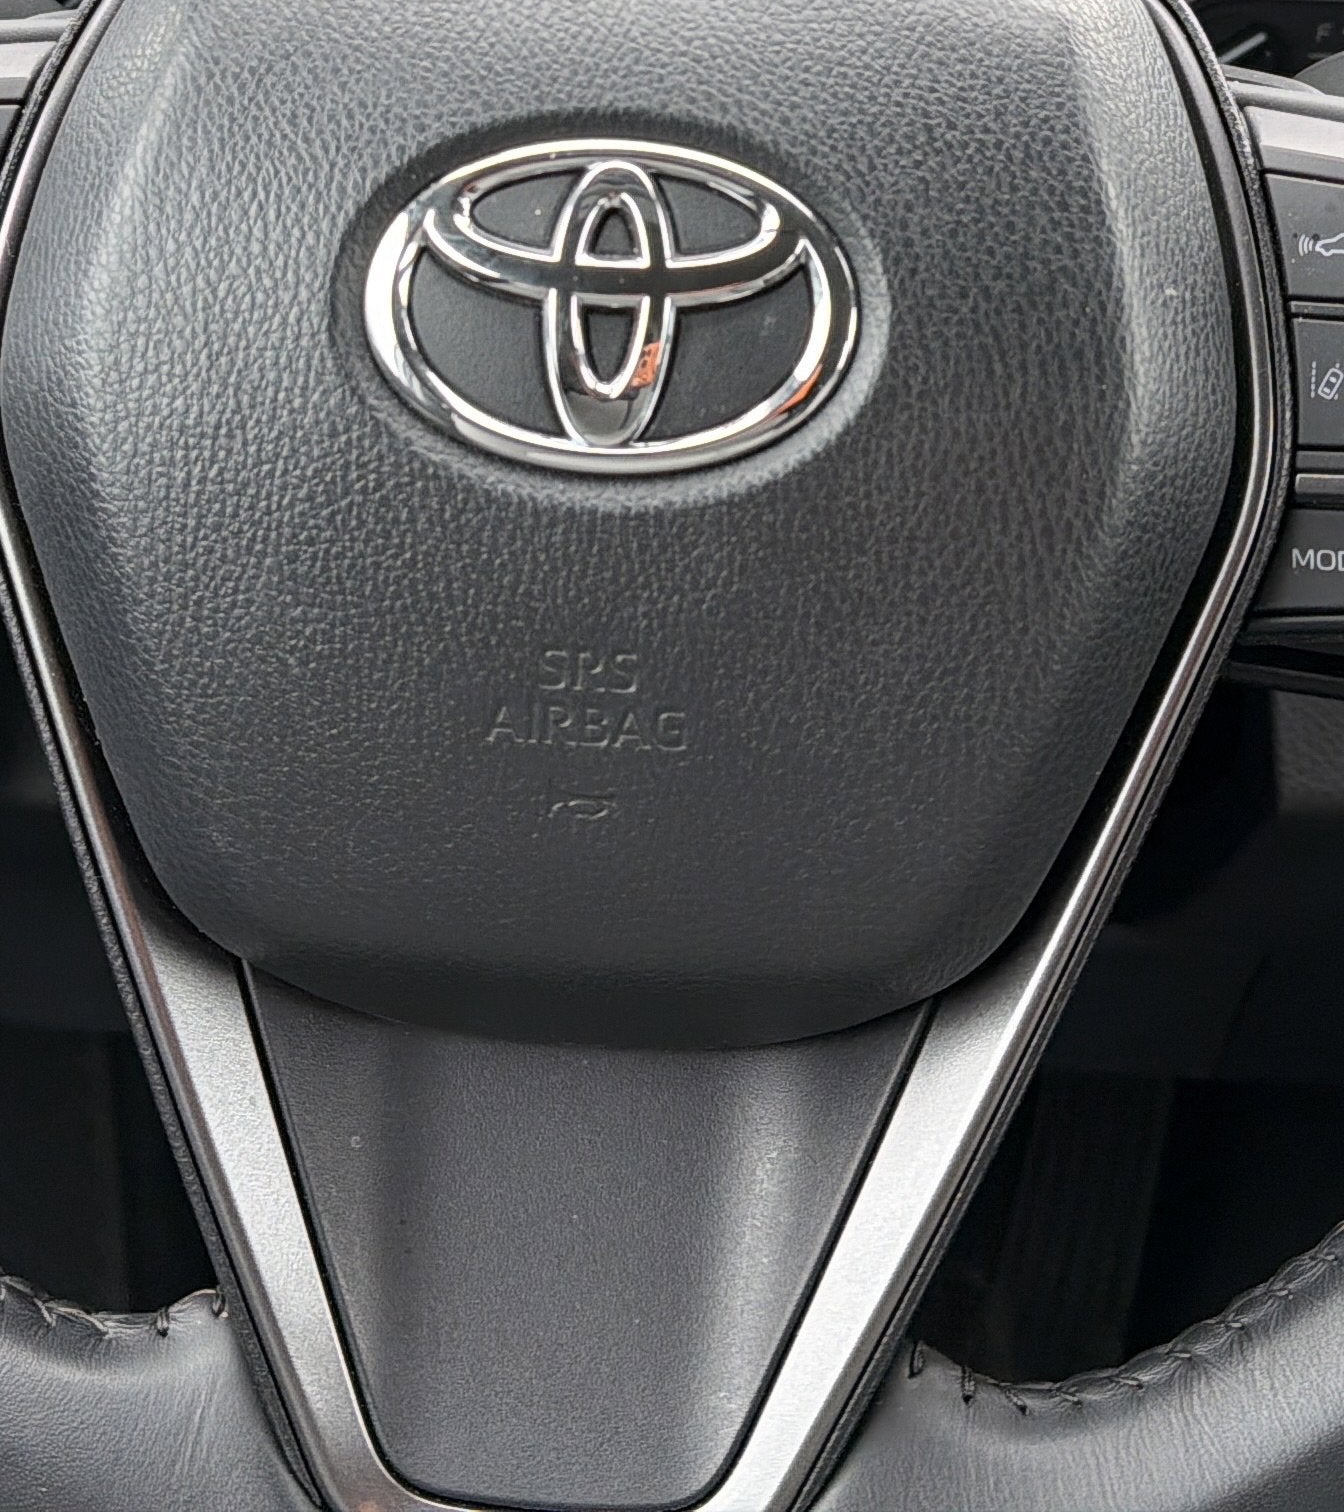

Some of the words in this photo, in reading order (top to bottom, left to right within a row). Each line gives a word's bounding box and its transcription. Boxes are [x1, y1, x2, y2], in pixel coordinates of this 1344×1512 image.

[1315, 22, 1334, 43] F
[537, 648, 640, 695] SRS
[483, 703, 690, 753] AIRBAG
